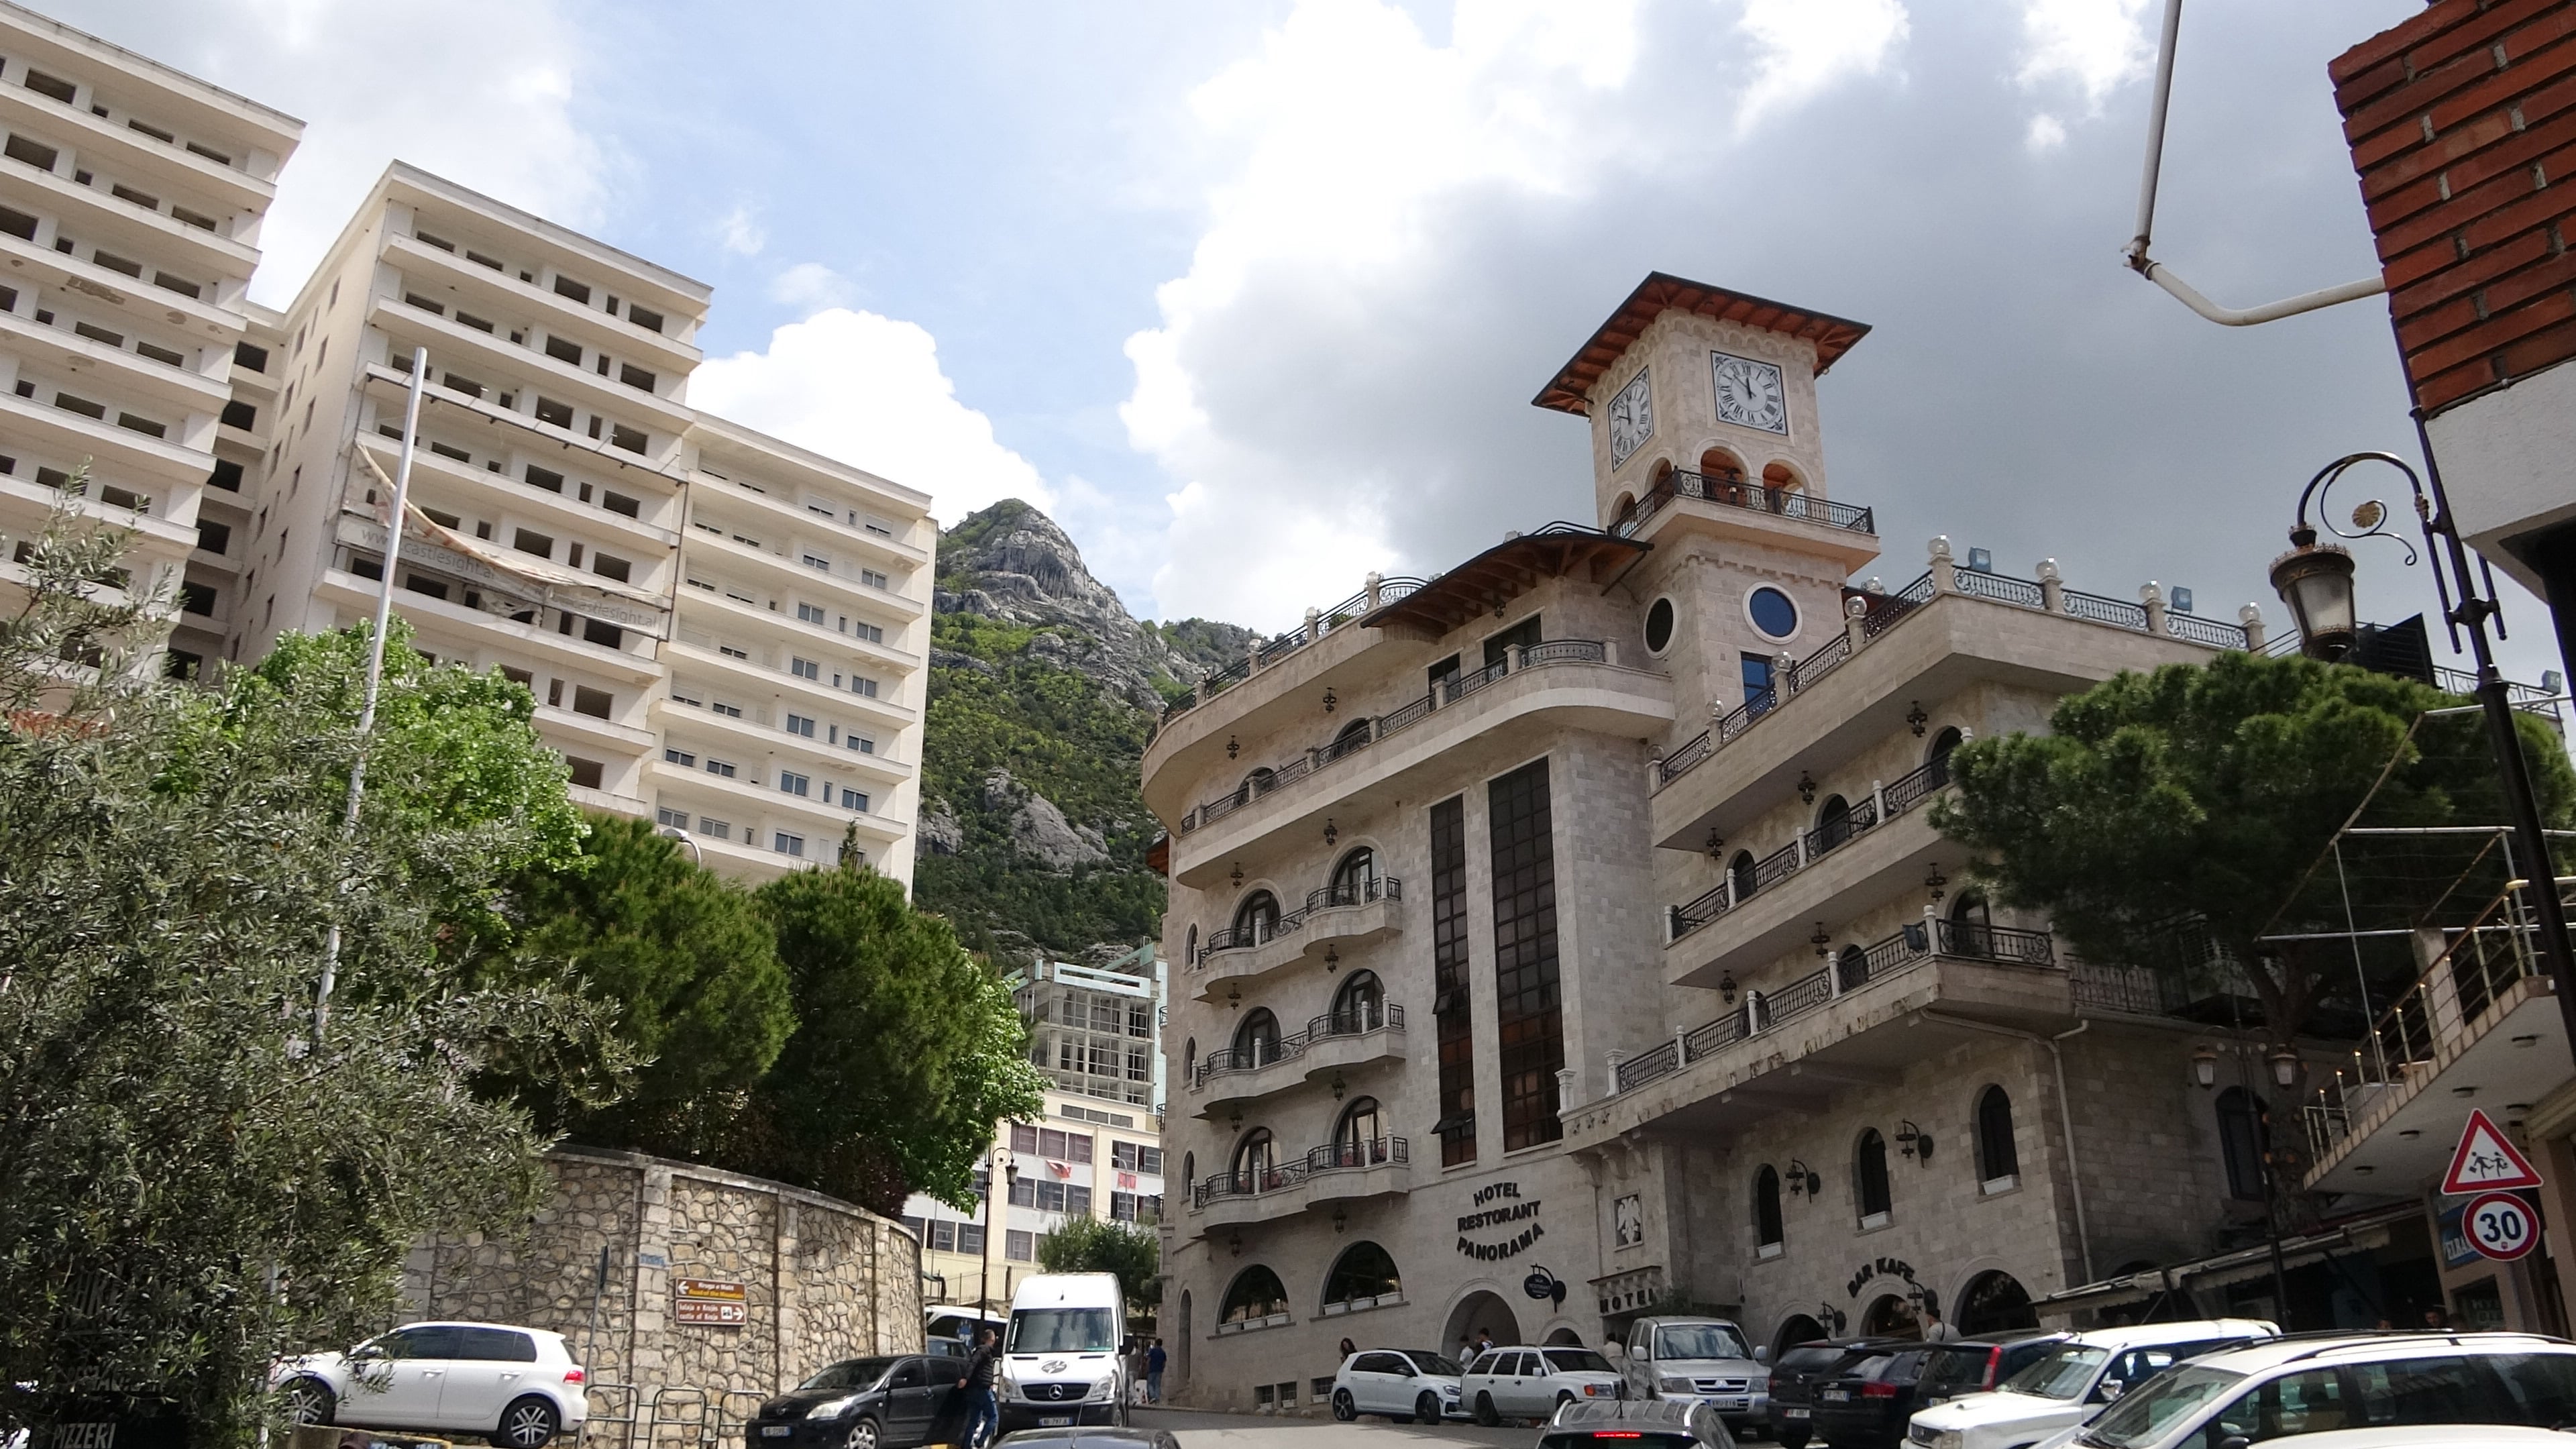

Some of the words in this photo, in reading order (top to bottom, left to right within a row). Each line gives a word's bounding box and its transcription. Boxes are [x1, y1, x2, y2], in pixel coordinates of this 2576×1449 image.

[1473, 1182, 1521, 1208] HOTEL
[1457, 1200, 1541, 1232] RESTORANT
[2479, 1210, 2522, 1242] 30
[1456, 1222, 1544, 1261] PANORAMA
[1847, 1264, 1874, 1298] BAR
[1876, 1257, 1915, 1284] KAFE
[1599, 1288, 1654, 1313] HOTEL
